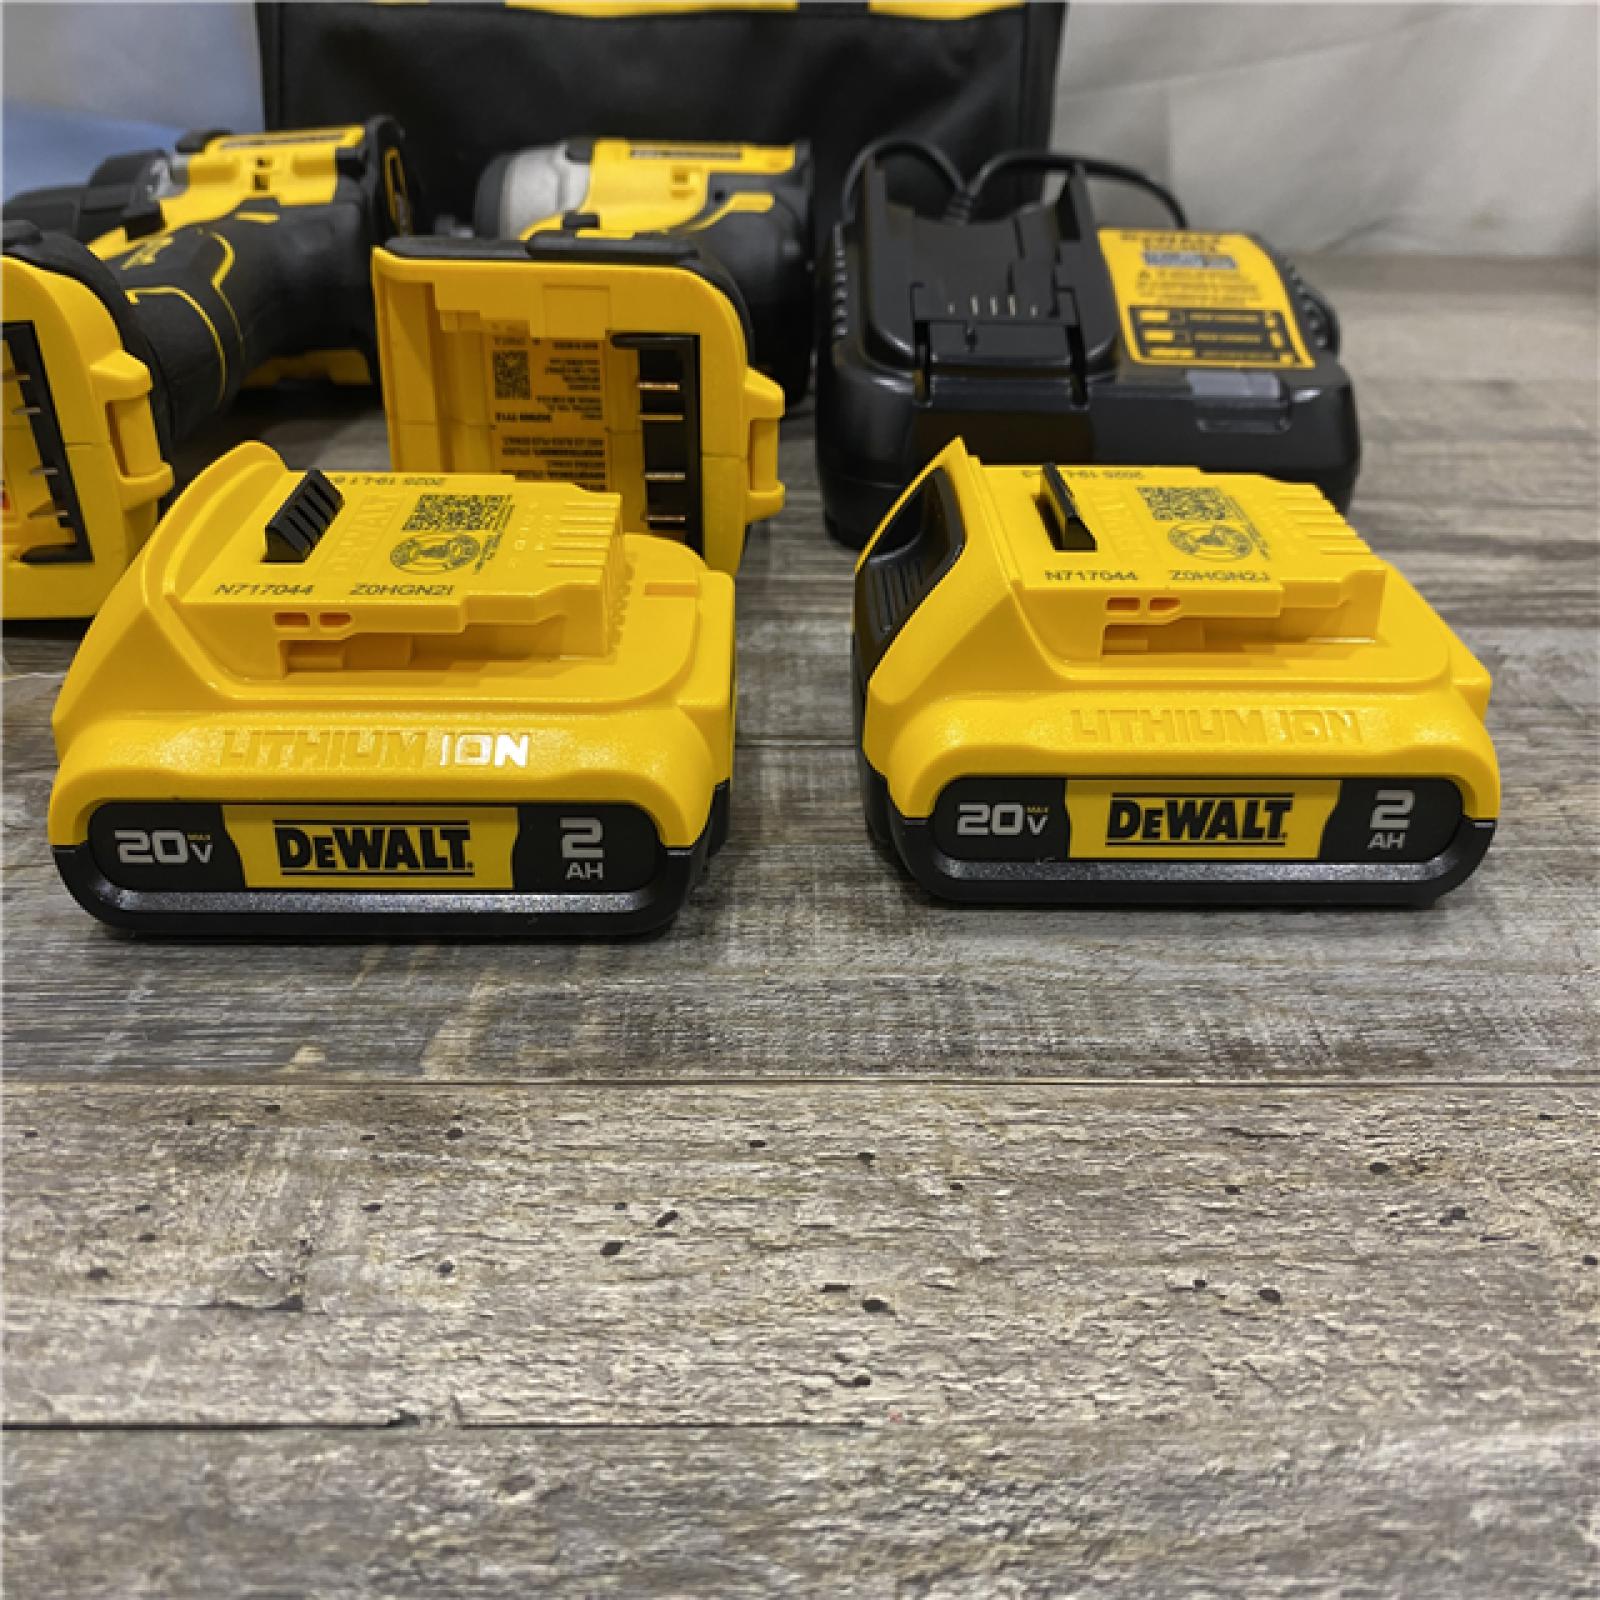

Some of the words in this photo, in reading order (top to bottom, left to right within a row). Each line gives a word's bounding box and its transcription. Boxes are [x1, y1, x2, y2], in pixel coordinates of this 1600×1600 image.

[1044, 569, 1138, 581] N717044
[214, 583, 315, 595] N717044
[1070, 709, 1266, 744] LITHIUM
[1278, 710, 1362, 745] ION
[220, 730, 429, 768] LITHIUM
[439, 733, 530, 768] ION
[1369, 789, 1415, 831] 2
[559, 818, 604, 859] 2
[1367, 832, 1407, 850] AH
[565, 862, 603, 880] AH
